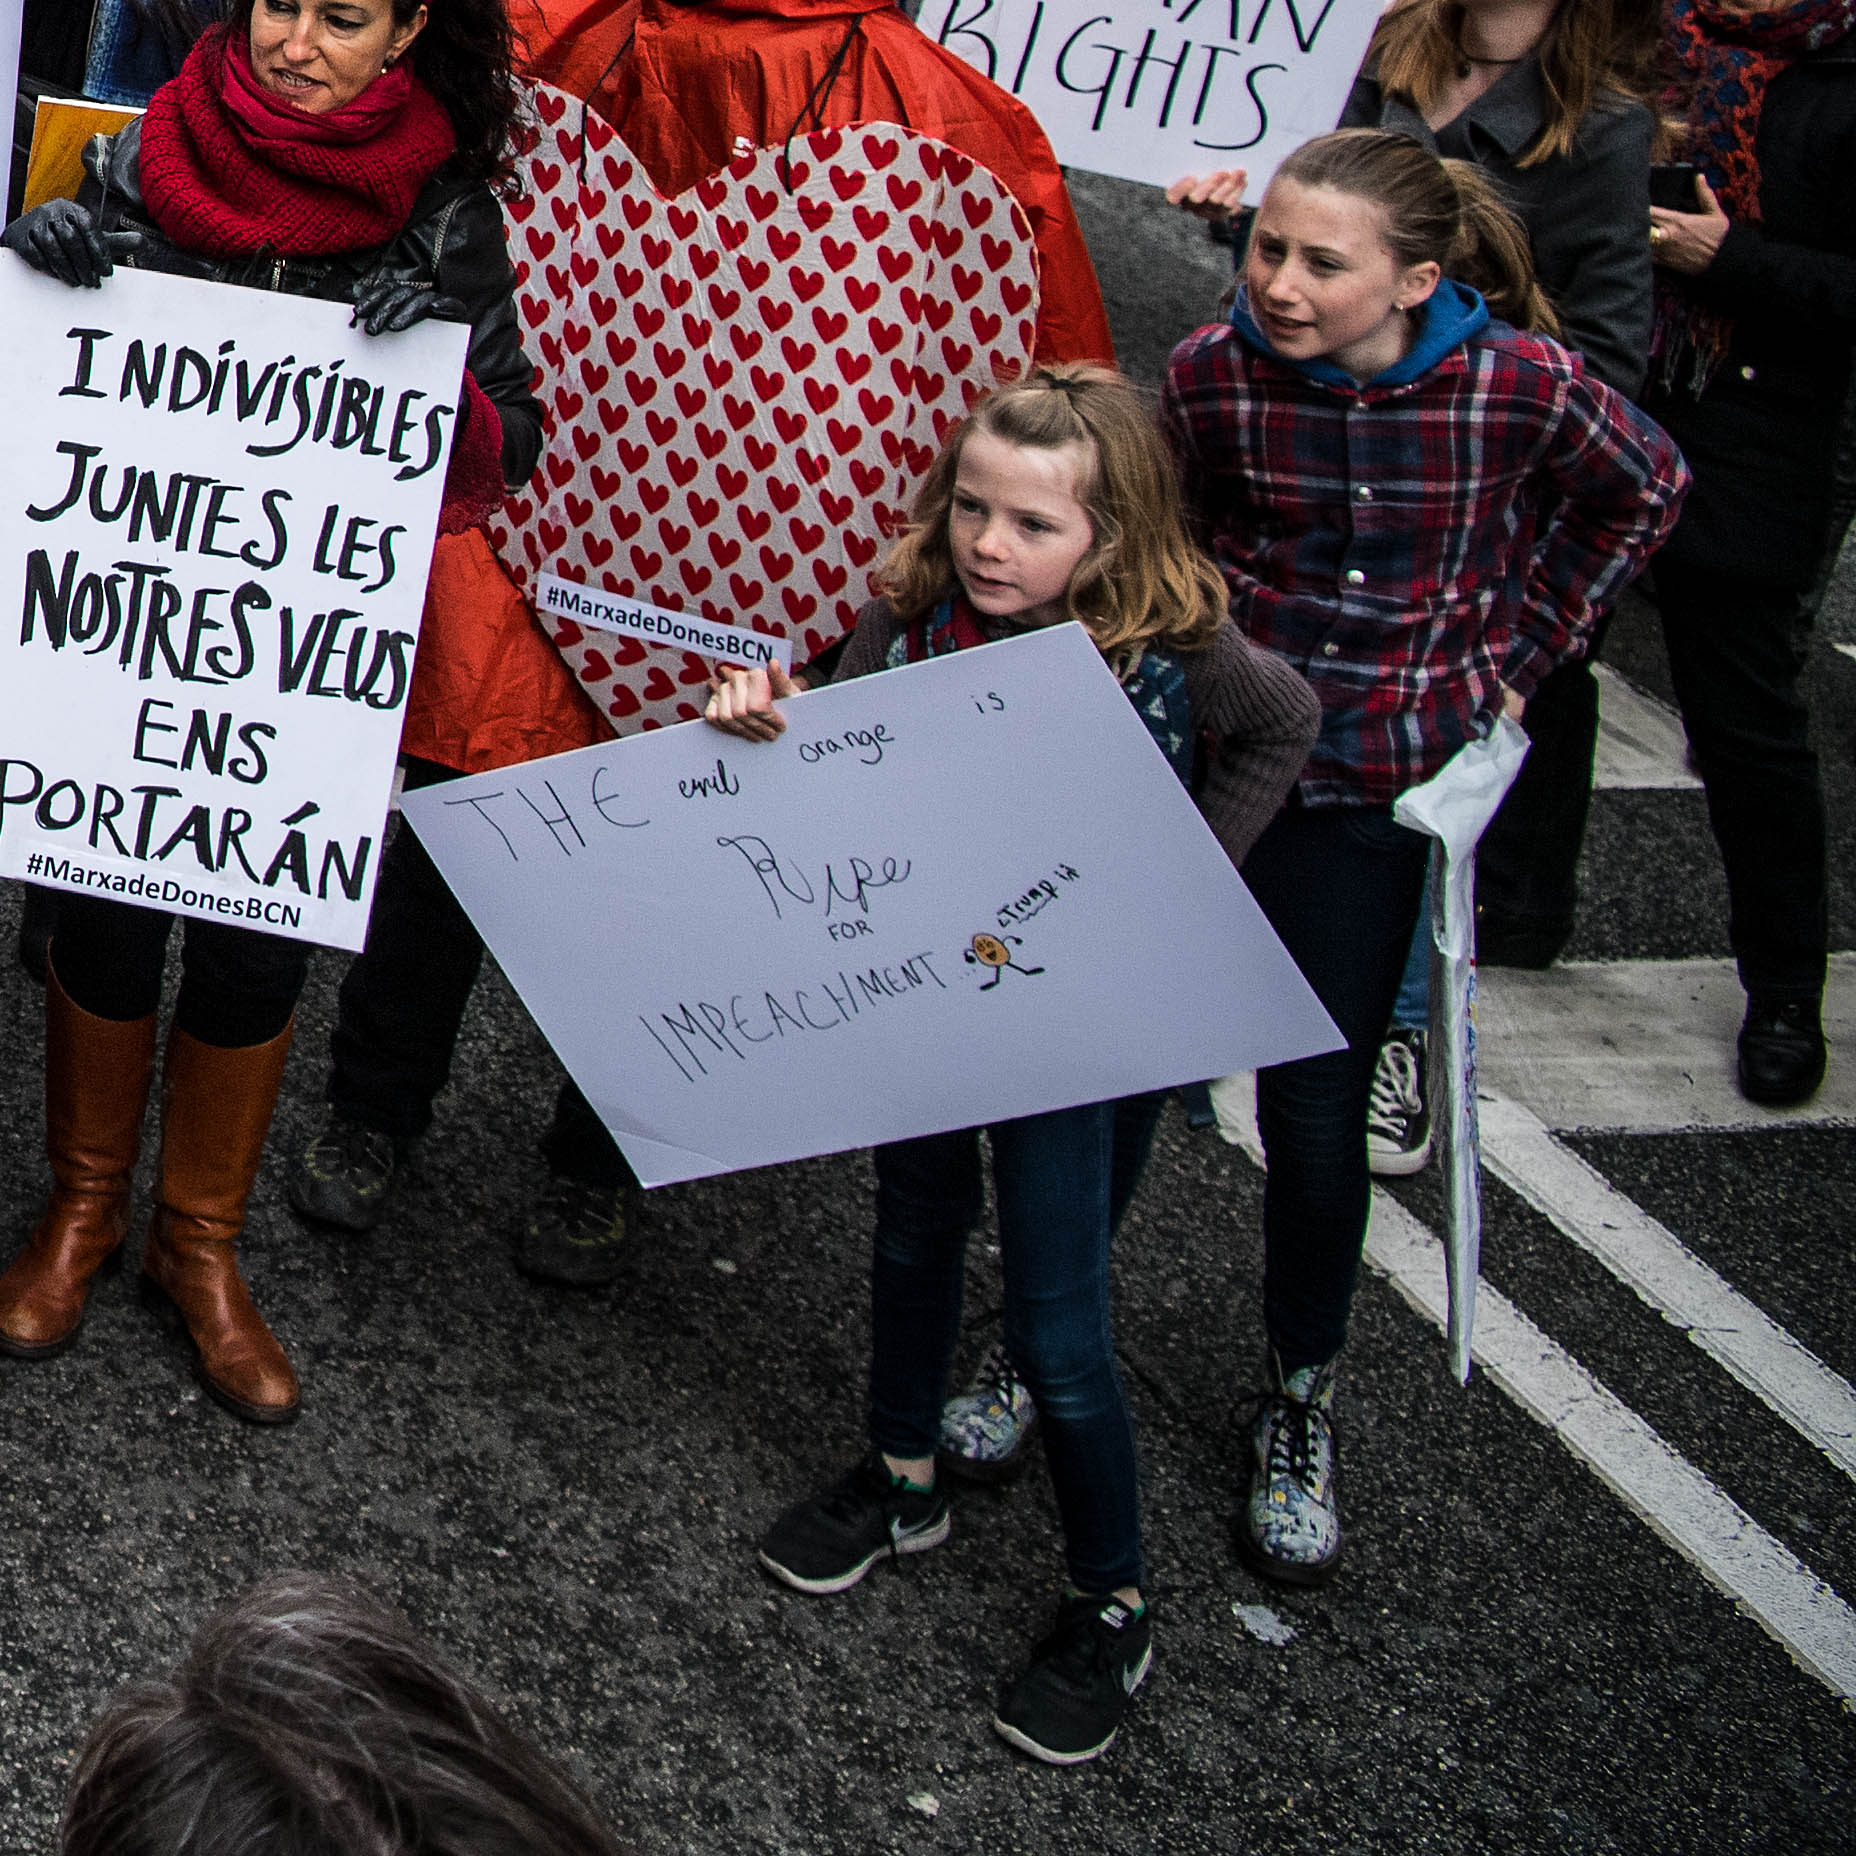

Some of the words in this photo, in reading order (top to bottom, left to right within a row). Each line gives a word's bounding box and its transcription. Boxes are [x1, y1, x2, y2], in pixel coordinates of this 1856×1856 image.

[25, 440, 293, 572] JUNTES
[312, 503, 408, 595] LES
[18, 548, 273, 686] NOSTRES
[277, 605, 417, 711] VEUS
[546, 586, 774, 664] #MarxadeDonesBCN
[132, 697, 278, 785] ENS
[443, 764, 652, 863] THE
[798, 718, 898, 767] orange
[973, 689, 1007, 718] is
[26, 852, 303, 930] #MarxadeDonesBCN
[716, 832, 914, 920] Ripe
[826, 917, 877, 944] FOR
